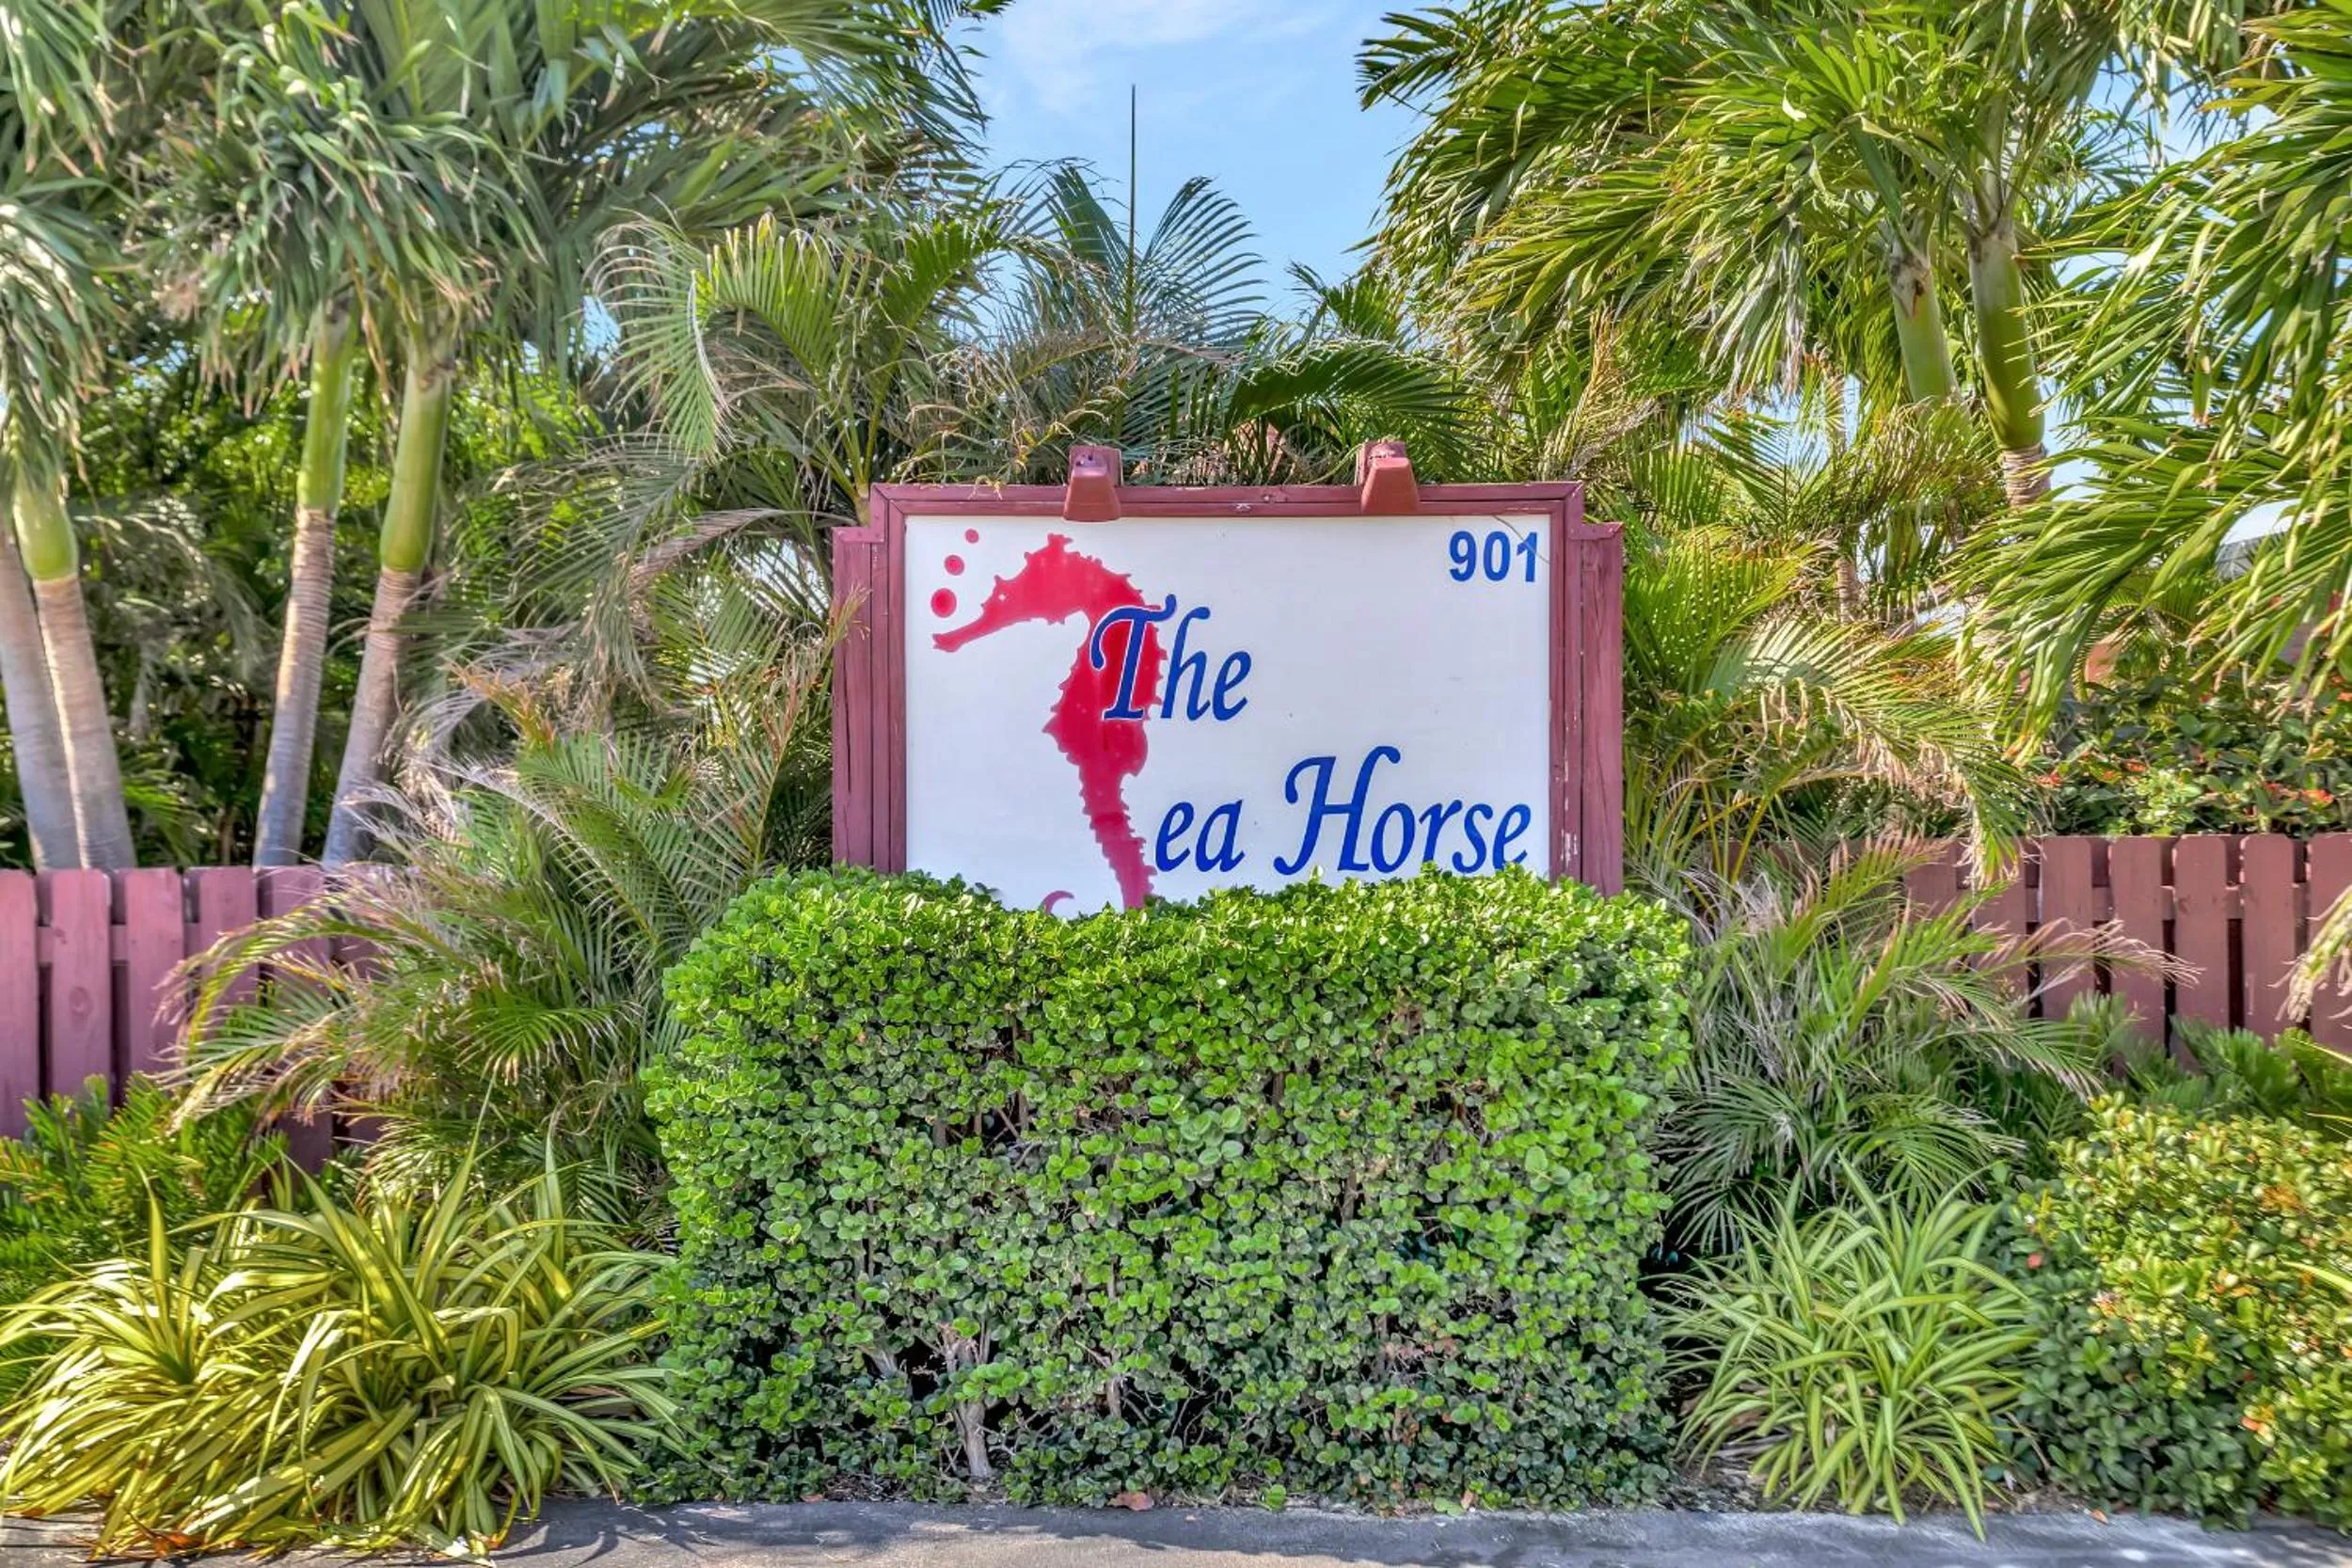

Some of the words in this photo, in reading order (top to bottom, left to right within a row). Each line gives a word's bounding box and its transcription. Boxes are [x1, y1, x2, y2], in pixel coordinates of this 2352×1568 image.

[1449, 530, 1538, 583] 901
[1090, 594, 1252, 721] The
[1272, 745, 1532, 876] Horse
